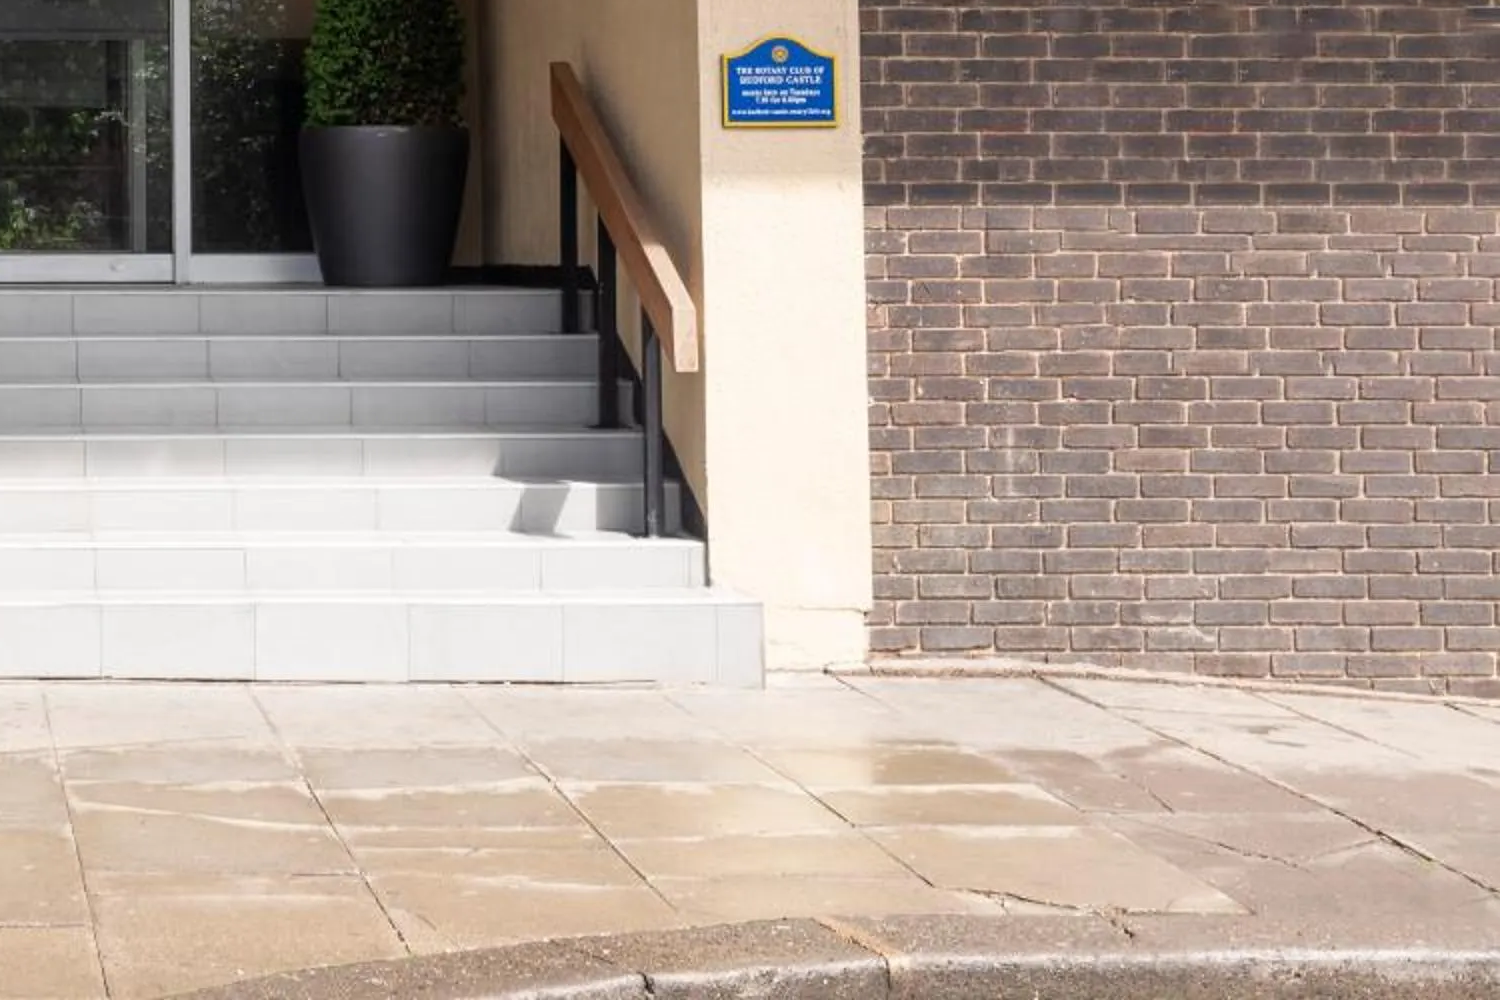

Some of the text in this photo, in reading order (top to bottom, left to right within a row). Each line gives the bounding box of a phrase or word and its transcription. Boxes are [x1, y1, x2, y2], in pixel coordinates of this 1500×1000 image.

[736, 66, 752, 75] THE
[789, 66, 812, 75] CLUB
[785, 75, 821, 85] CASTLE
